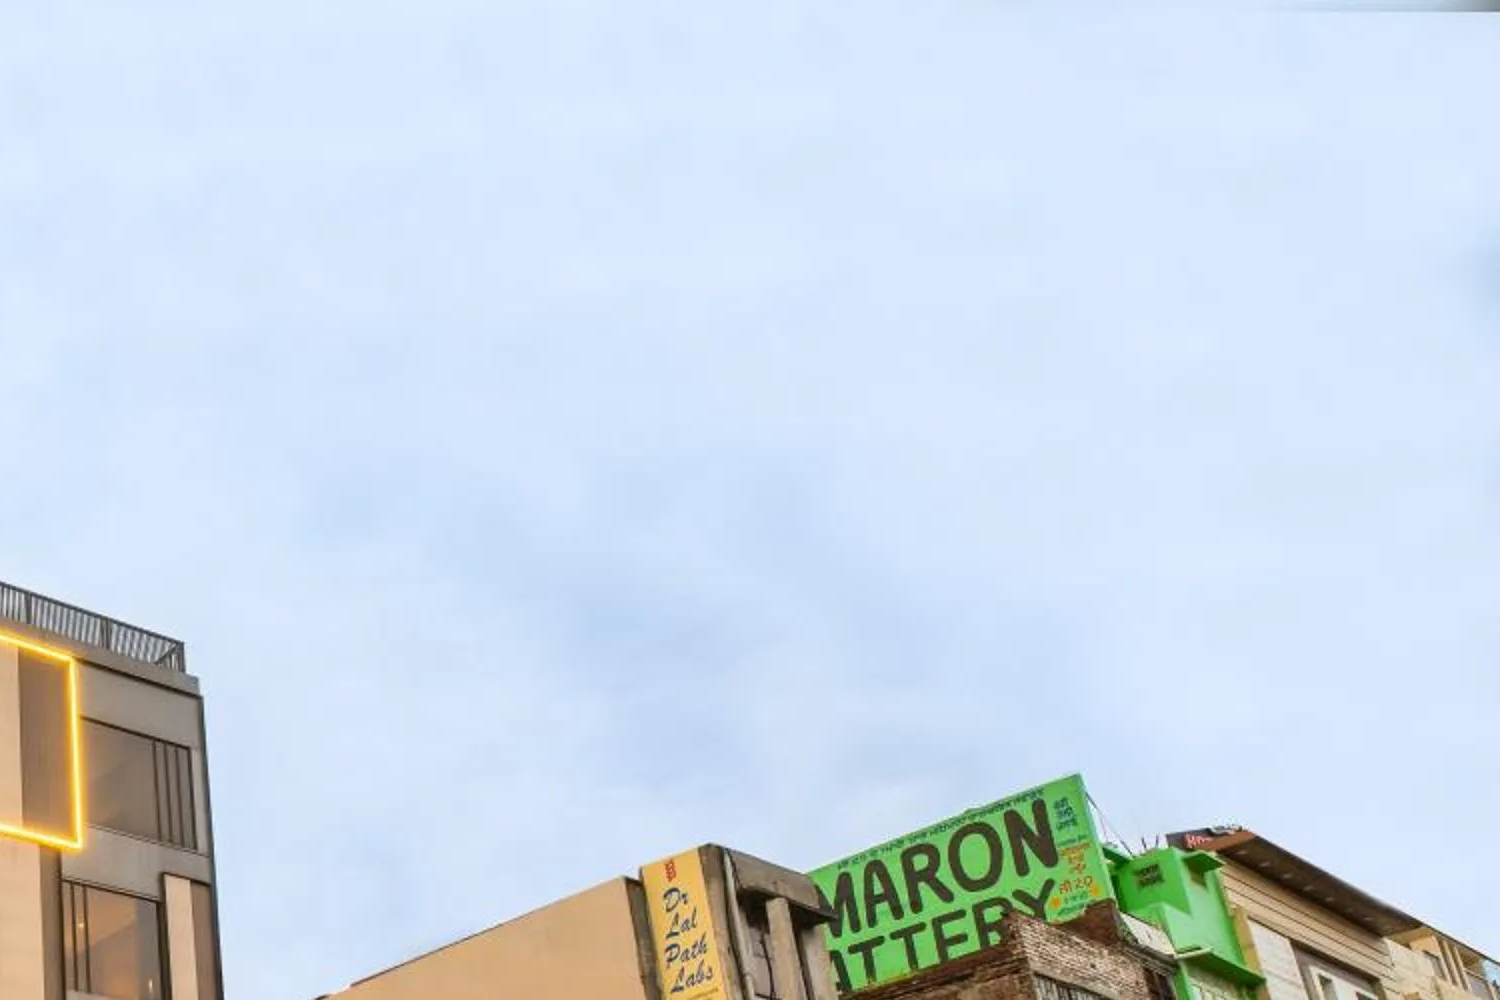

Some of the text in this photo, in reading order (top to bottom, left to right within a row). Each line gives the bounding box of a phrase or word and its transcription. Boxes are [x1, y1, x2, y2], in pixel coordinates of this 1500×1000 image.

[663, 887, 688, 913] Dr
[666, 907, 698, 940] Lal
[664, 931, 709, 969] Path
[669, 959, 714, 994] Labs
